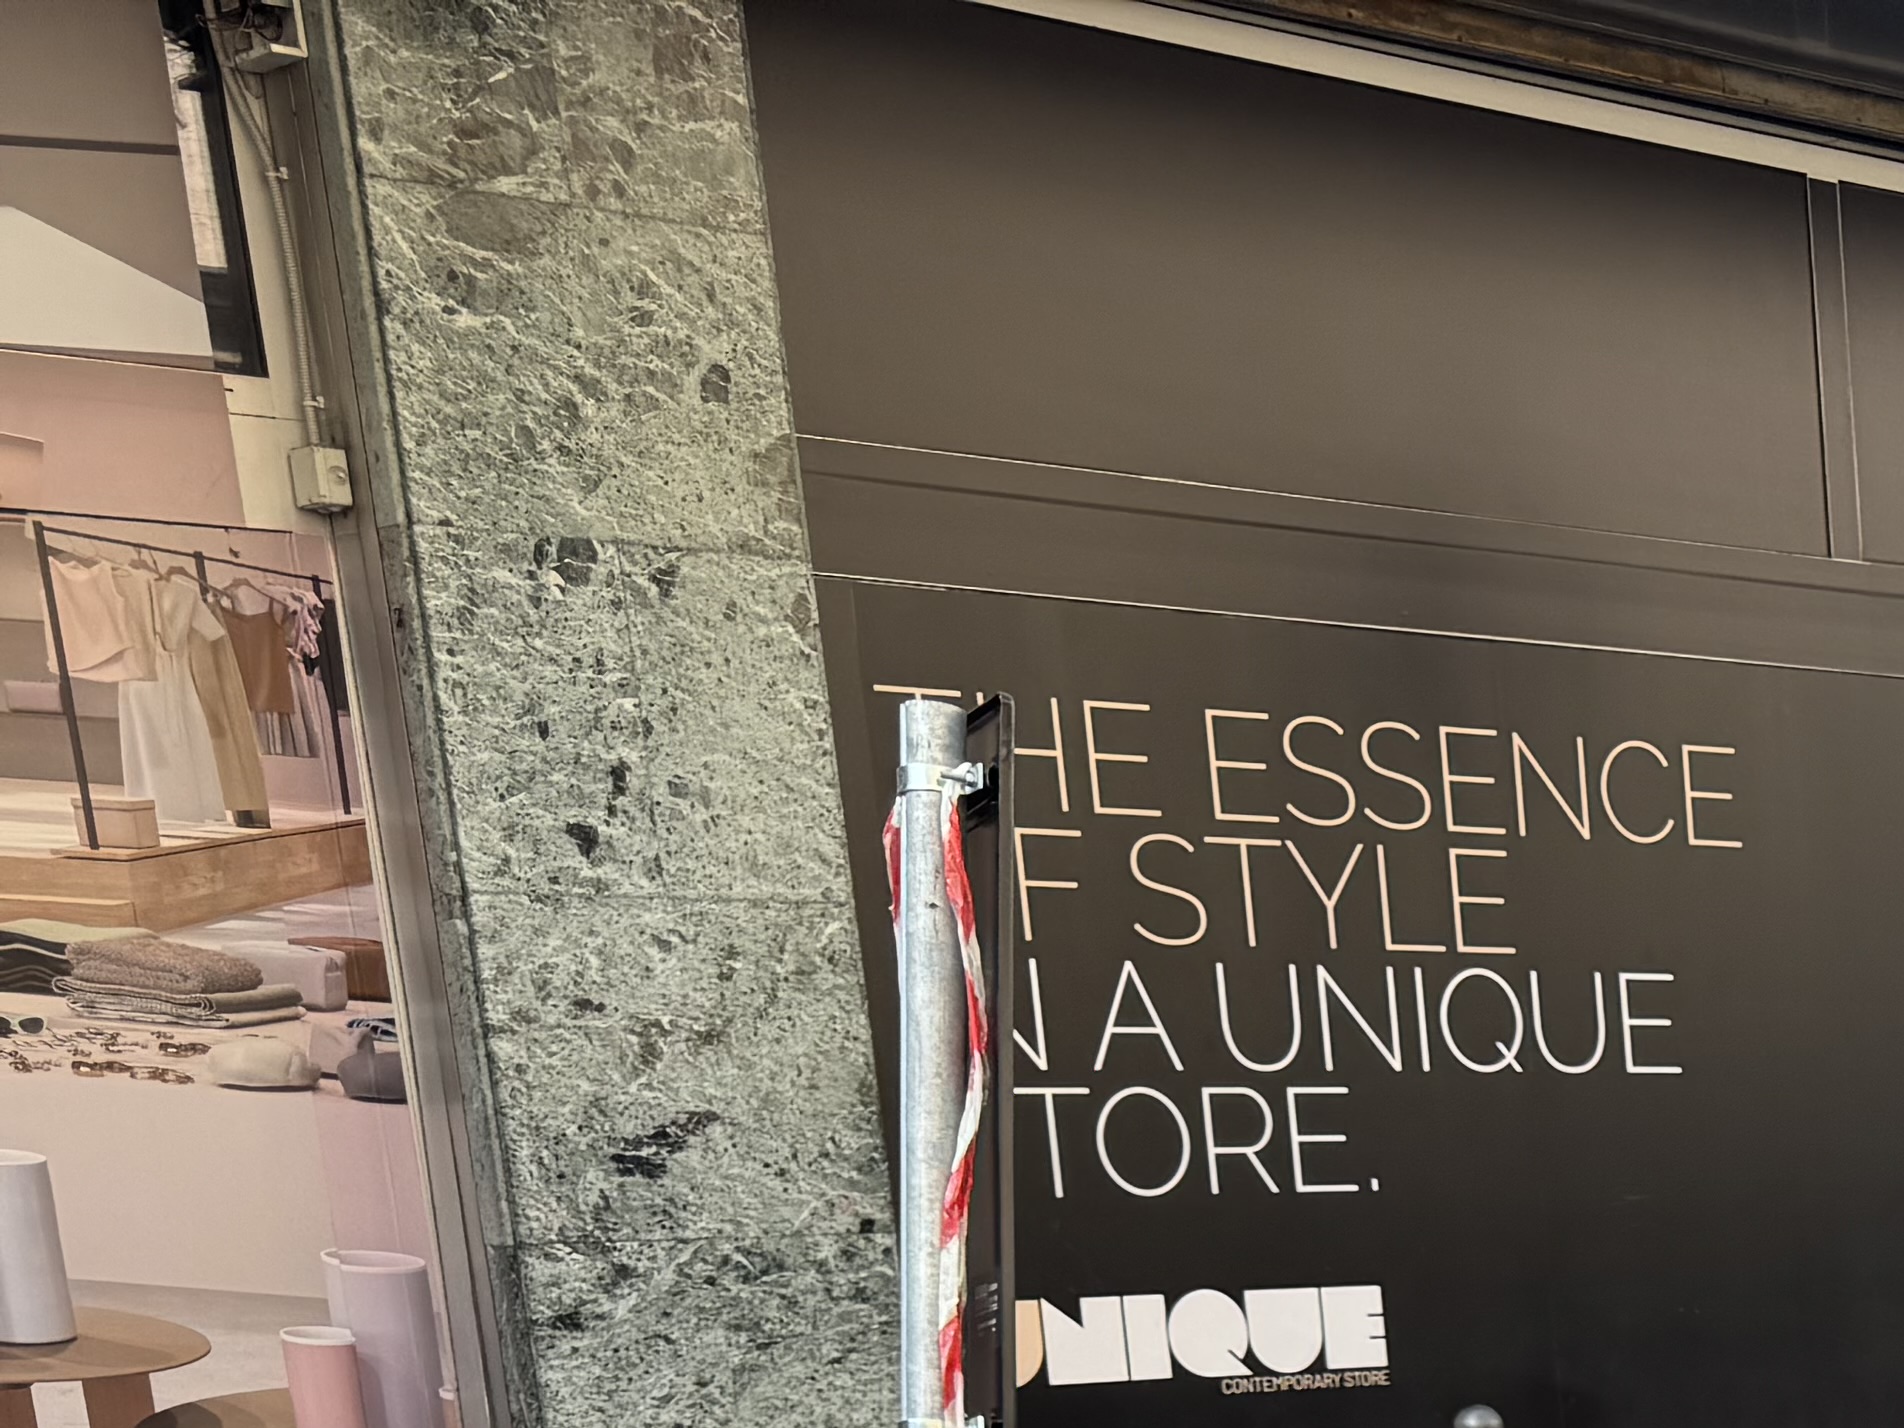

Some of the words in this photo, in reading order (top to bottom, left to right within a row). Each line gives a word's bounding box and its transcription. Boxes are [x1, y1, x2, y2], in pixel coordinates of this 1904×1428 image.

[1204, 708, 1743, 849] ESSENCE
[1129, 832, 1517, 954] STYLE
[1094, 958, 1184, 1074] A
[1215, 961, 1683, 1076] UNIQUE
[1014, 1084, 1381, 1199] TORE.
[1221, 1372, 1342, 1396] CONTEMPORARY
[1343, 1369, 1392, 1389] STORE
